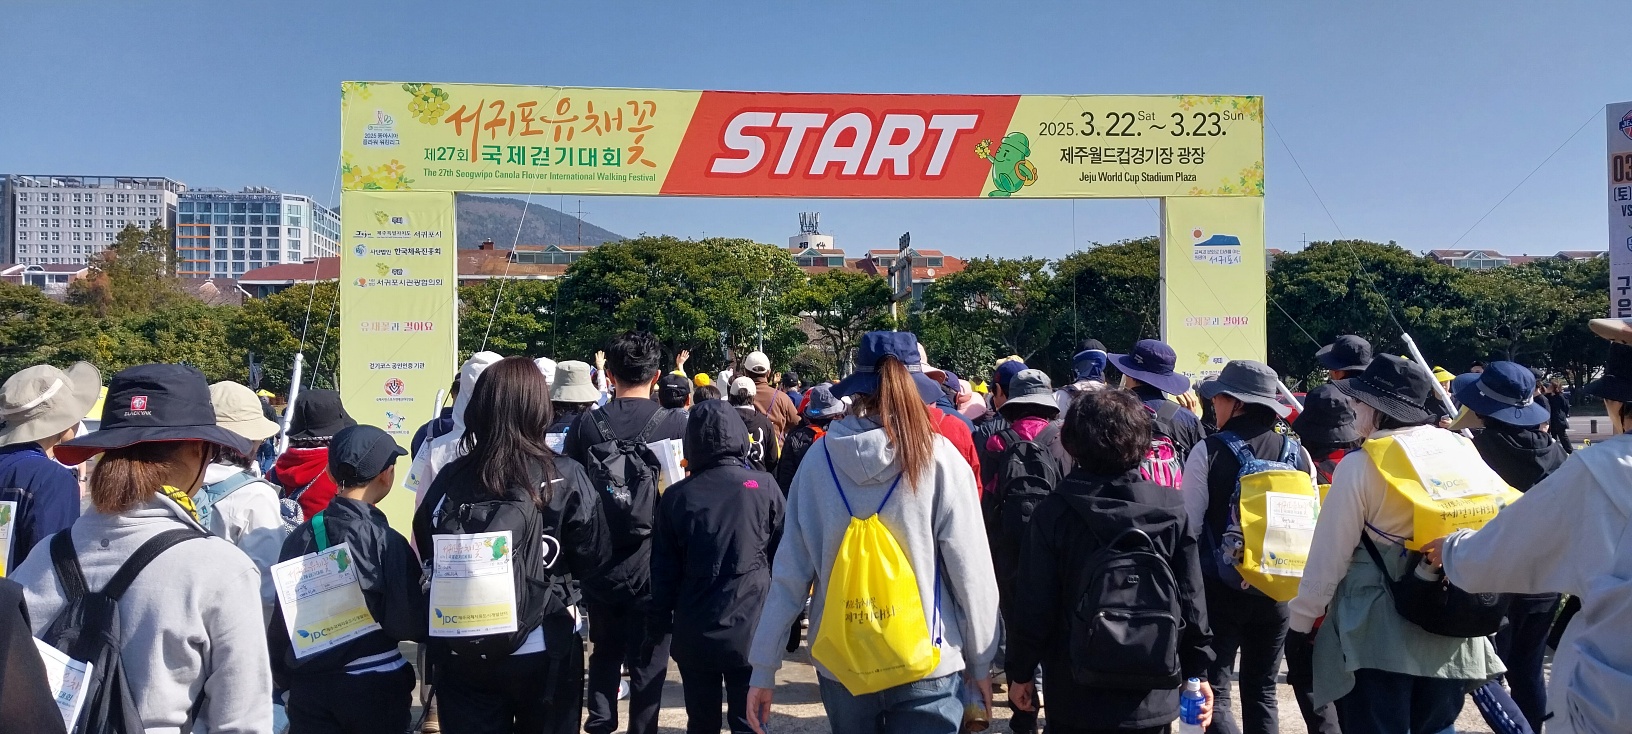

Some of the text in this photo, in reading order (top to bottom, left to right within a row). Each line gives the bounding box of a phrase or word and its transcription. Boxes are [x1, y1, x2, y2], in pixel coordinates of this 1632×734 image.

[1138, 110, 1156, 121] Sat
[1223, 110, 1244, 121] Sun
[710, 111, 979, 176] START
[423, 144, 621, 168] 제27회 국제걷기대회
[1060, 146, 1206, 165] 제주월드컵경기장 광장
[423, 168, 437, 177] The
[438, 168, 454, 177] 27th
[455, 169, 493, 180] Seogwipo
[494, 169, 520, 178] Canola
[549, 171, 596, 181] International
[596, 172, 627, 182] Walking
[628, 173, 656, 182] Festival
[1079, 172, 1197, 184] Jeju World Cup Stadium Plaza
[414, 230, 442, 238] 서귀포시
[1274, 558, 1289, 567] JDC
[442, 615, 458, 625] JDC
[310, 628, 328, 643] JDC
